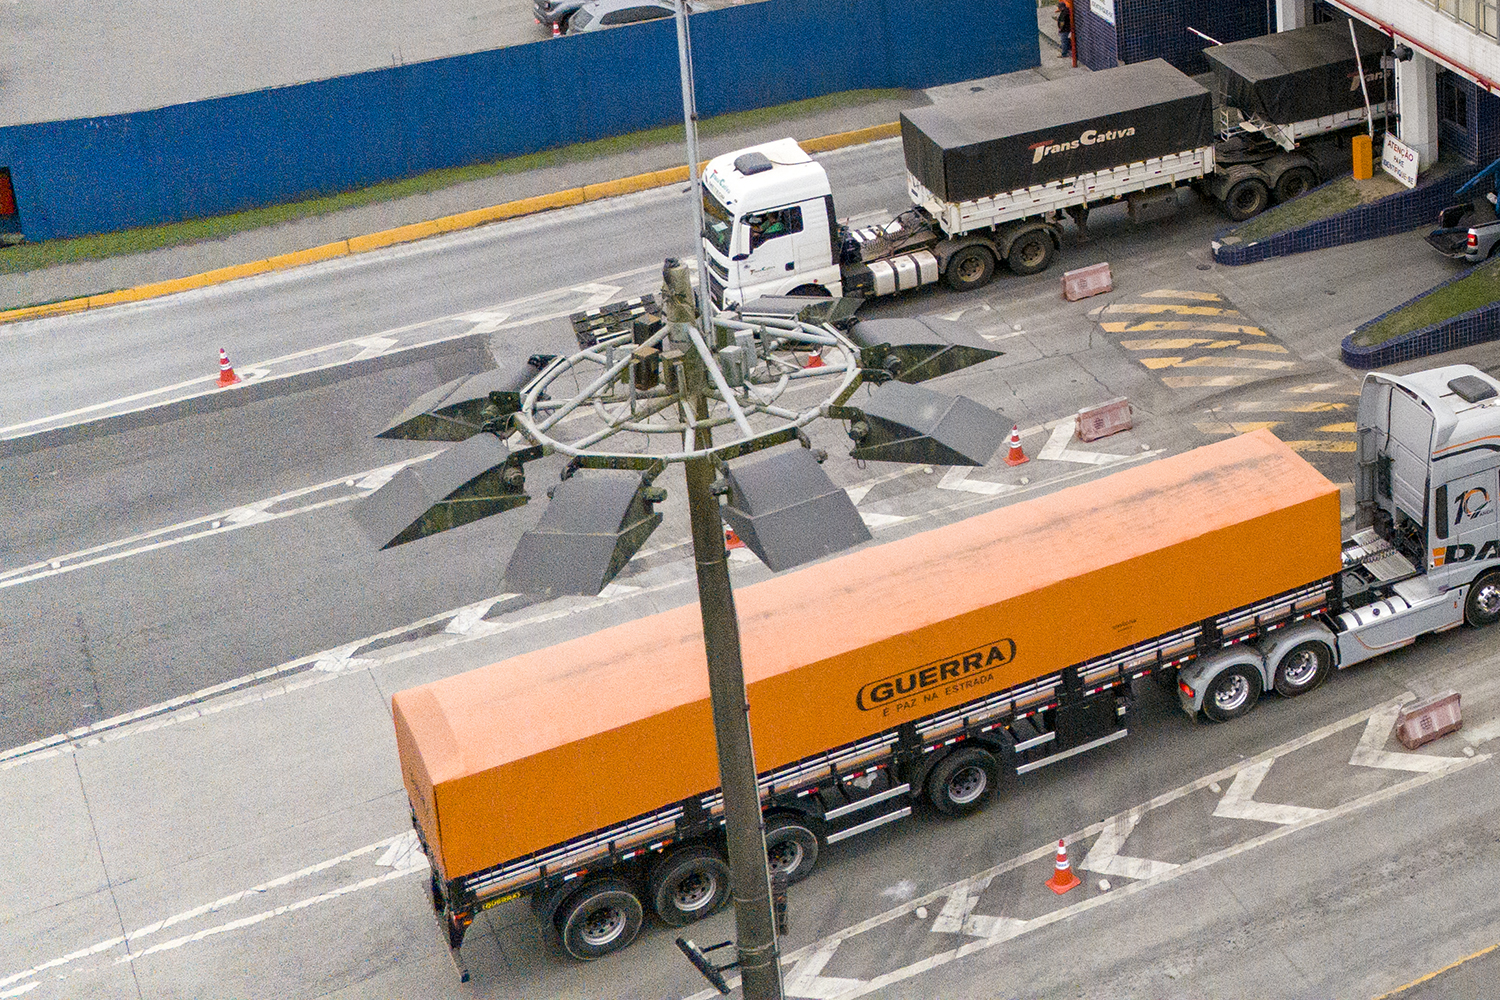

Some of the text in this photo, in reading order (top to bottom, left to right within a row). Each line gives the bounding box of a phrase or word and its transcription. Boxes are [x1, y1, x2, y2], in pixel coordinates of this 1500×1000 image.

[1028, 127, 1136, 164] TransCativa
[1387, 140, 1414, 162] ATENÇÃO
[870, 646, 1006, 702] GUERRA
[896, 698, 917, 712] PAZ
[924, 692, 939, 703] NA
[945, 673, 994, 696] ESTRADA
